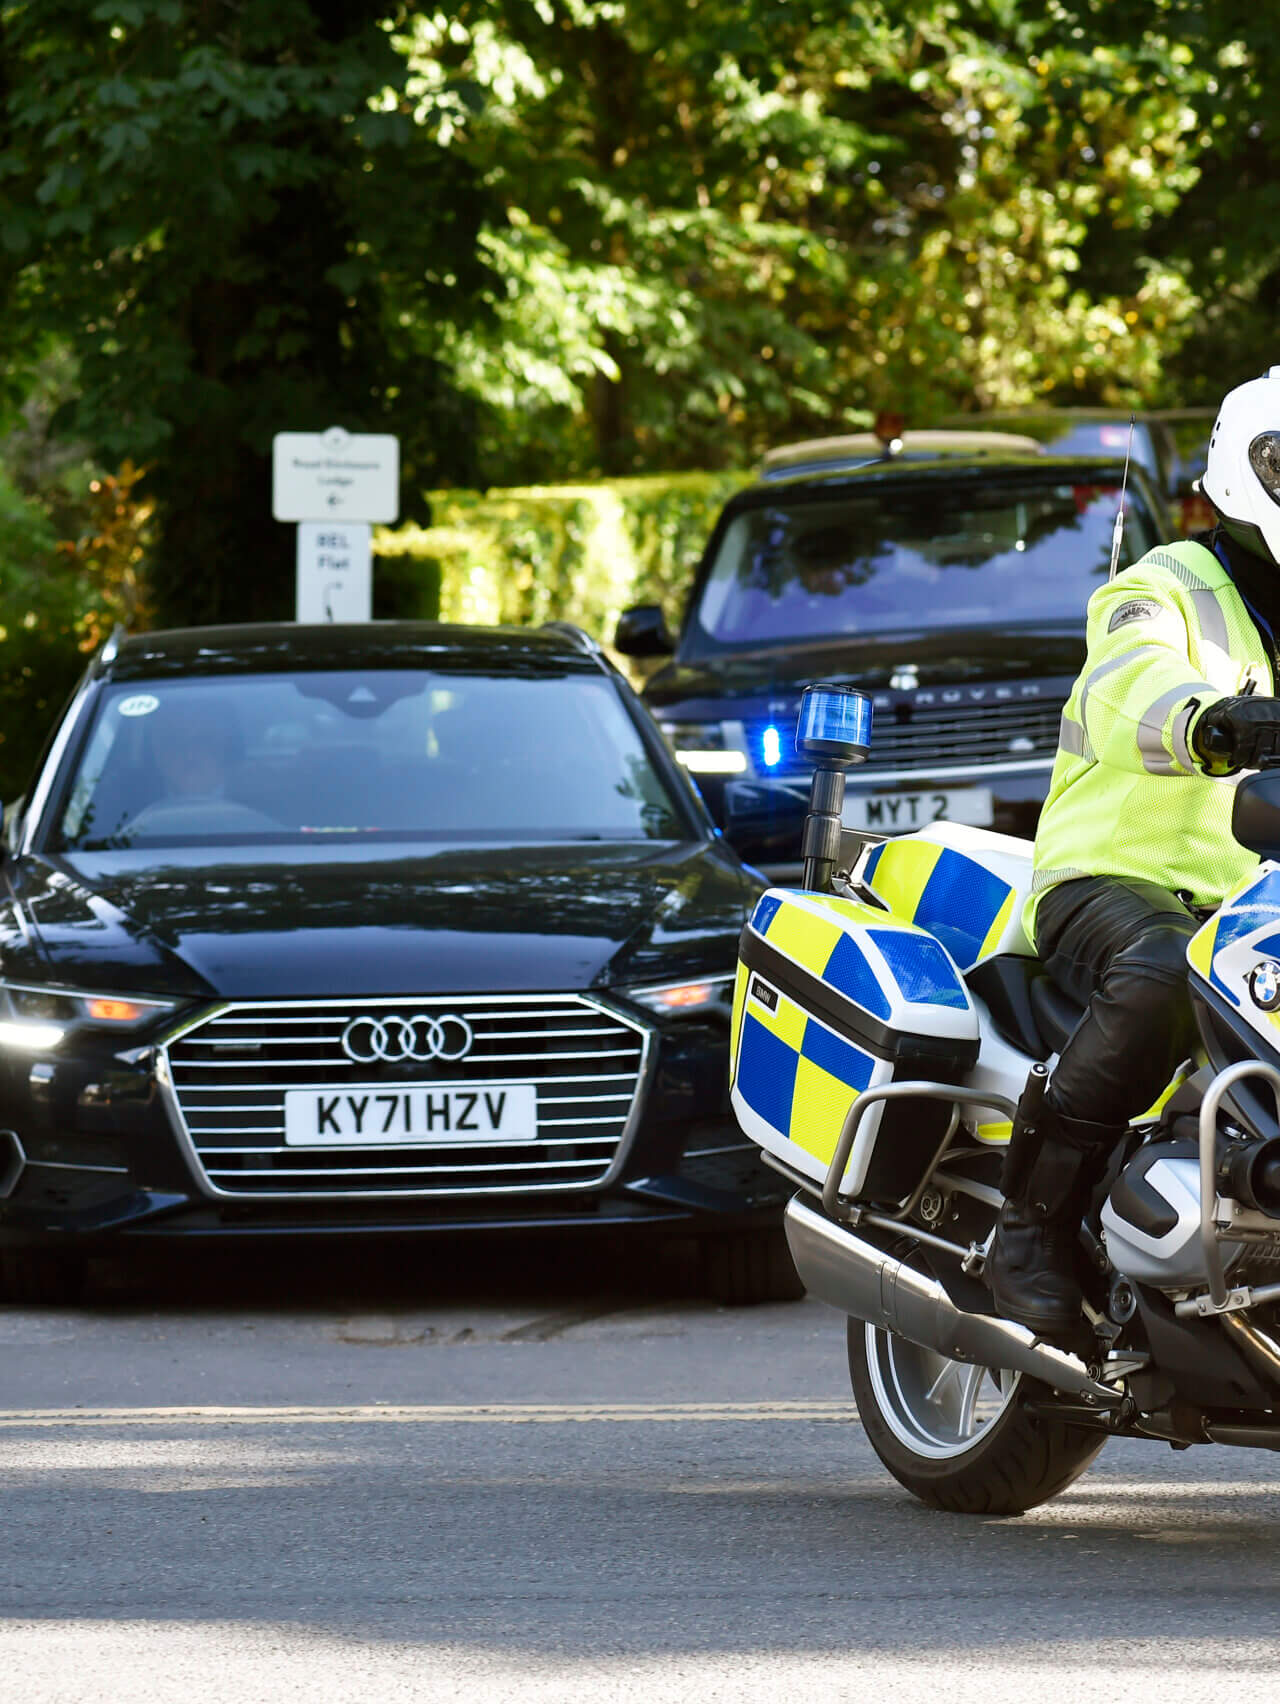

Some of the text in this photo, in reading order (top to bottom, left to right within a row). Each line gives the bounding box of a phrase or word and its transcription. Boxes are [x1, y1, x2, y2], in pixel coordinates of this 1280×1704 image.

[866, 795, 949, 826] MYT 2
[316, 1091, 507, 1135] KY71 HZV
